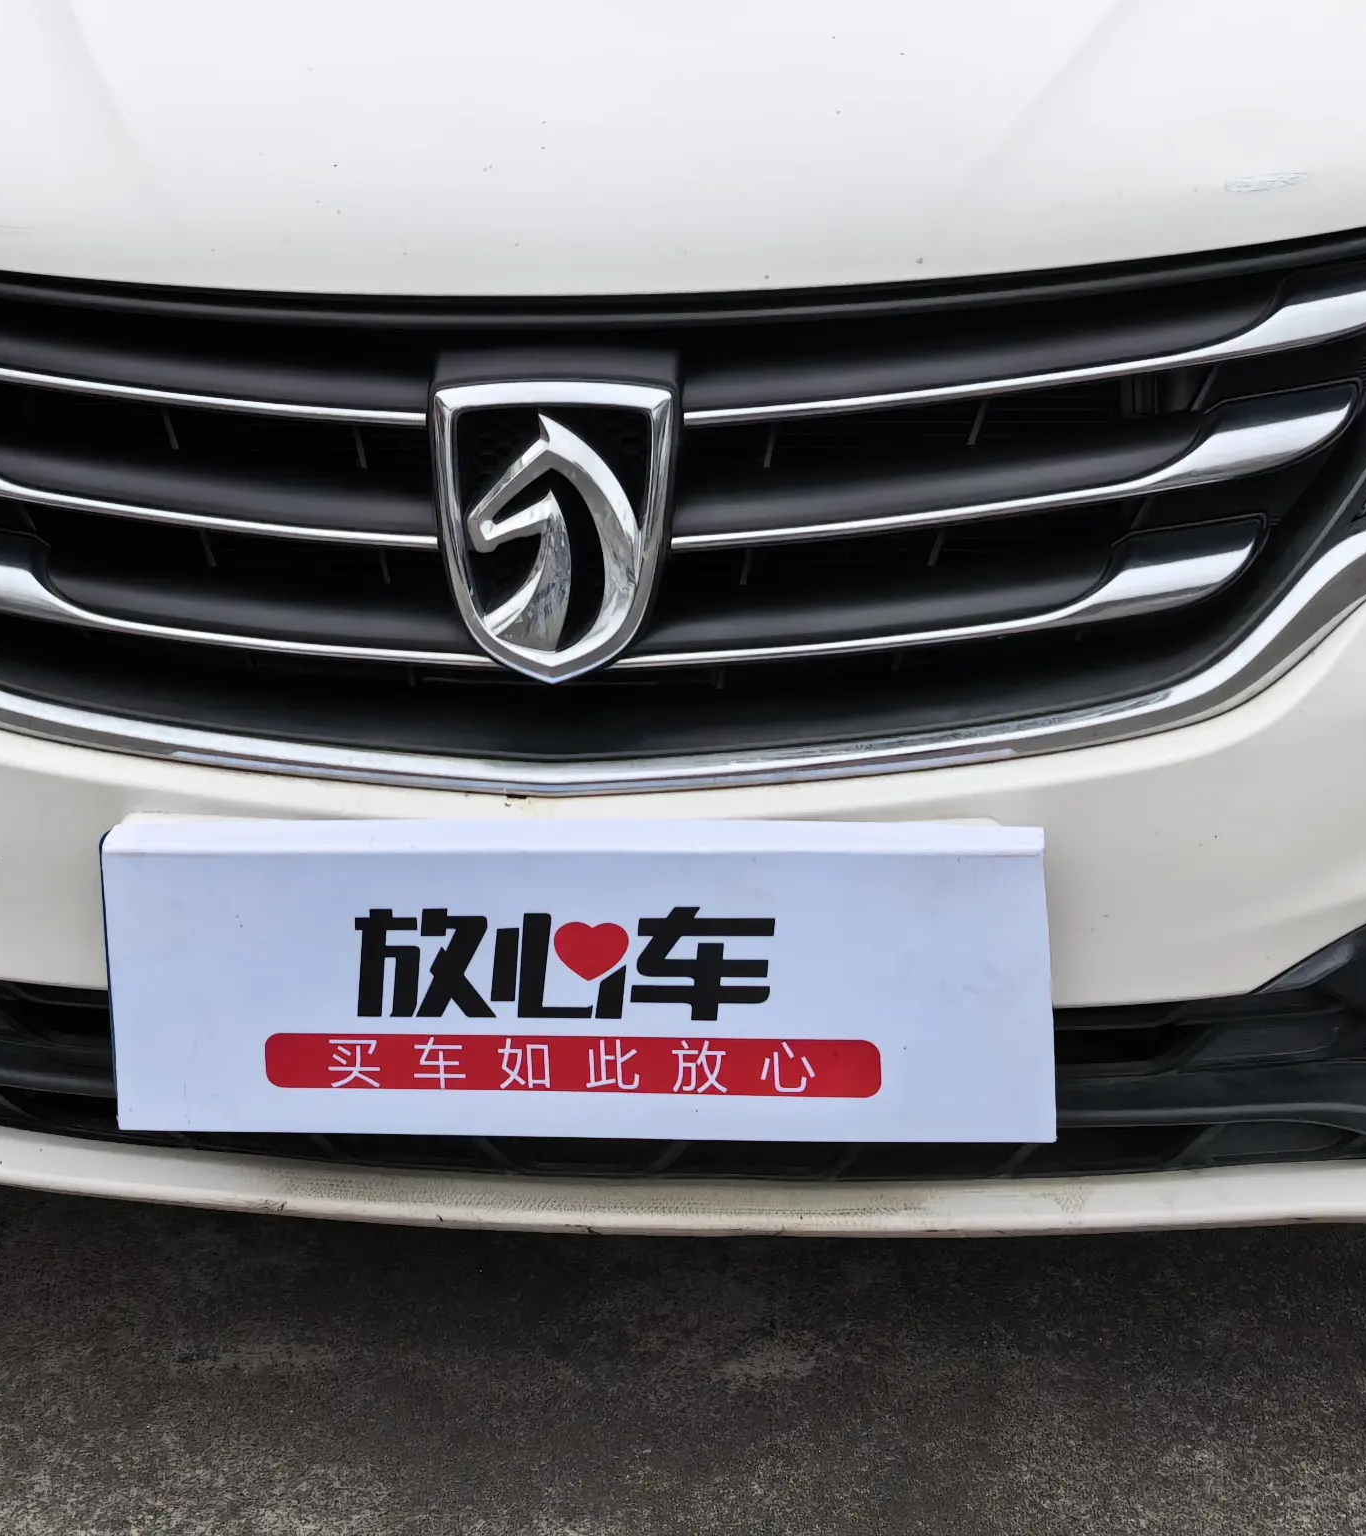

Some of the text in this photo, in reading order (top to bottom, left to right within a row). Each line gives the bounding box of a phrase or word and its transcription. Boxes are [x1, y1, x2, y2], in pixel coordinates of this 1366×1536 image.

[354, 906, 776, 1022] 放心车
[327, 1037, 816, 1095] 买车如此放心
